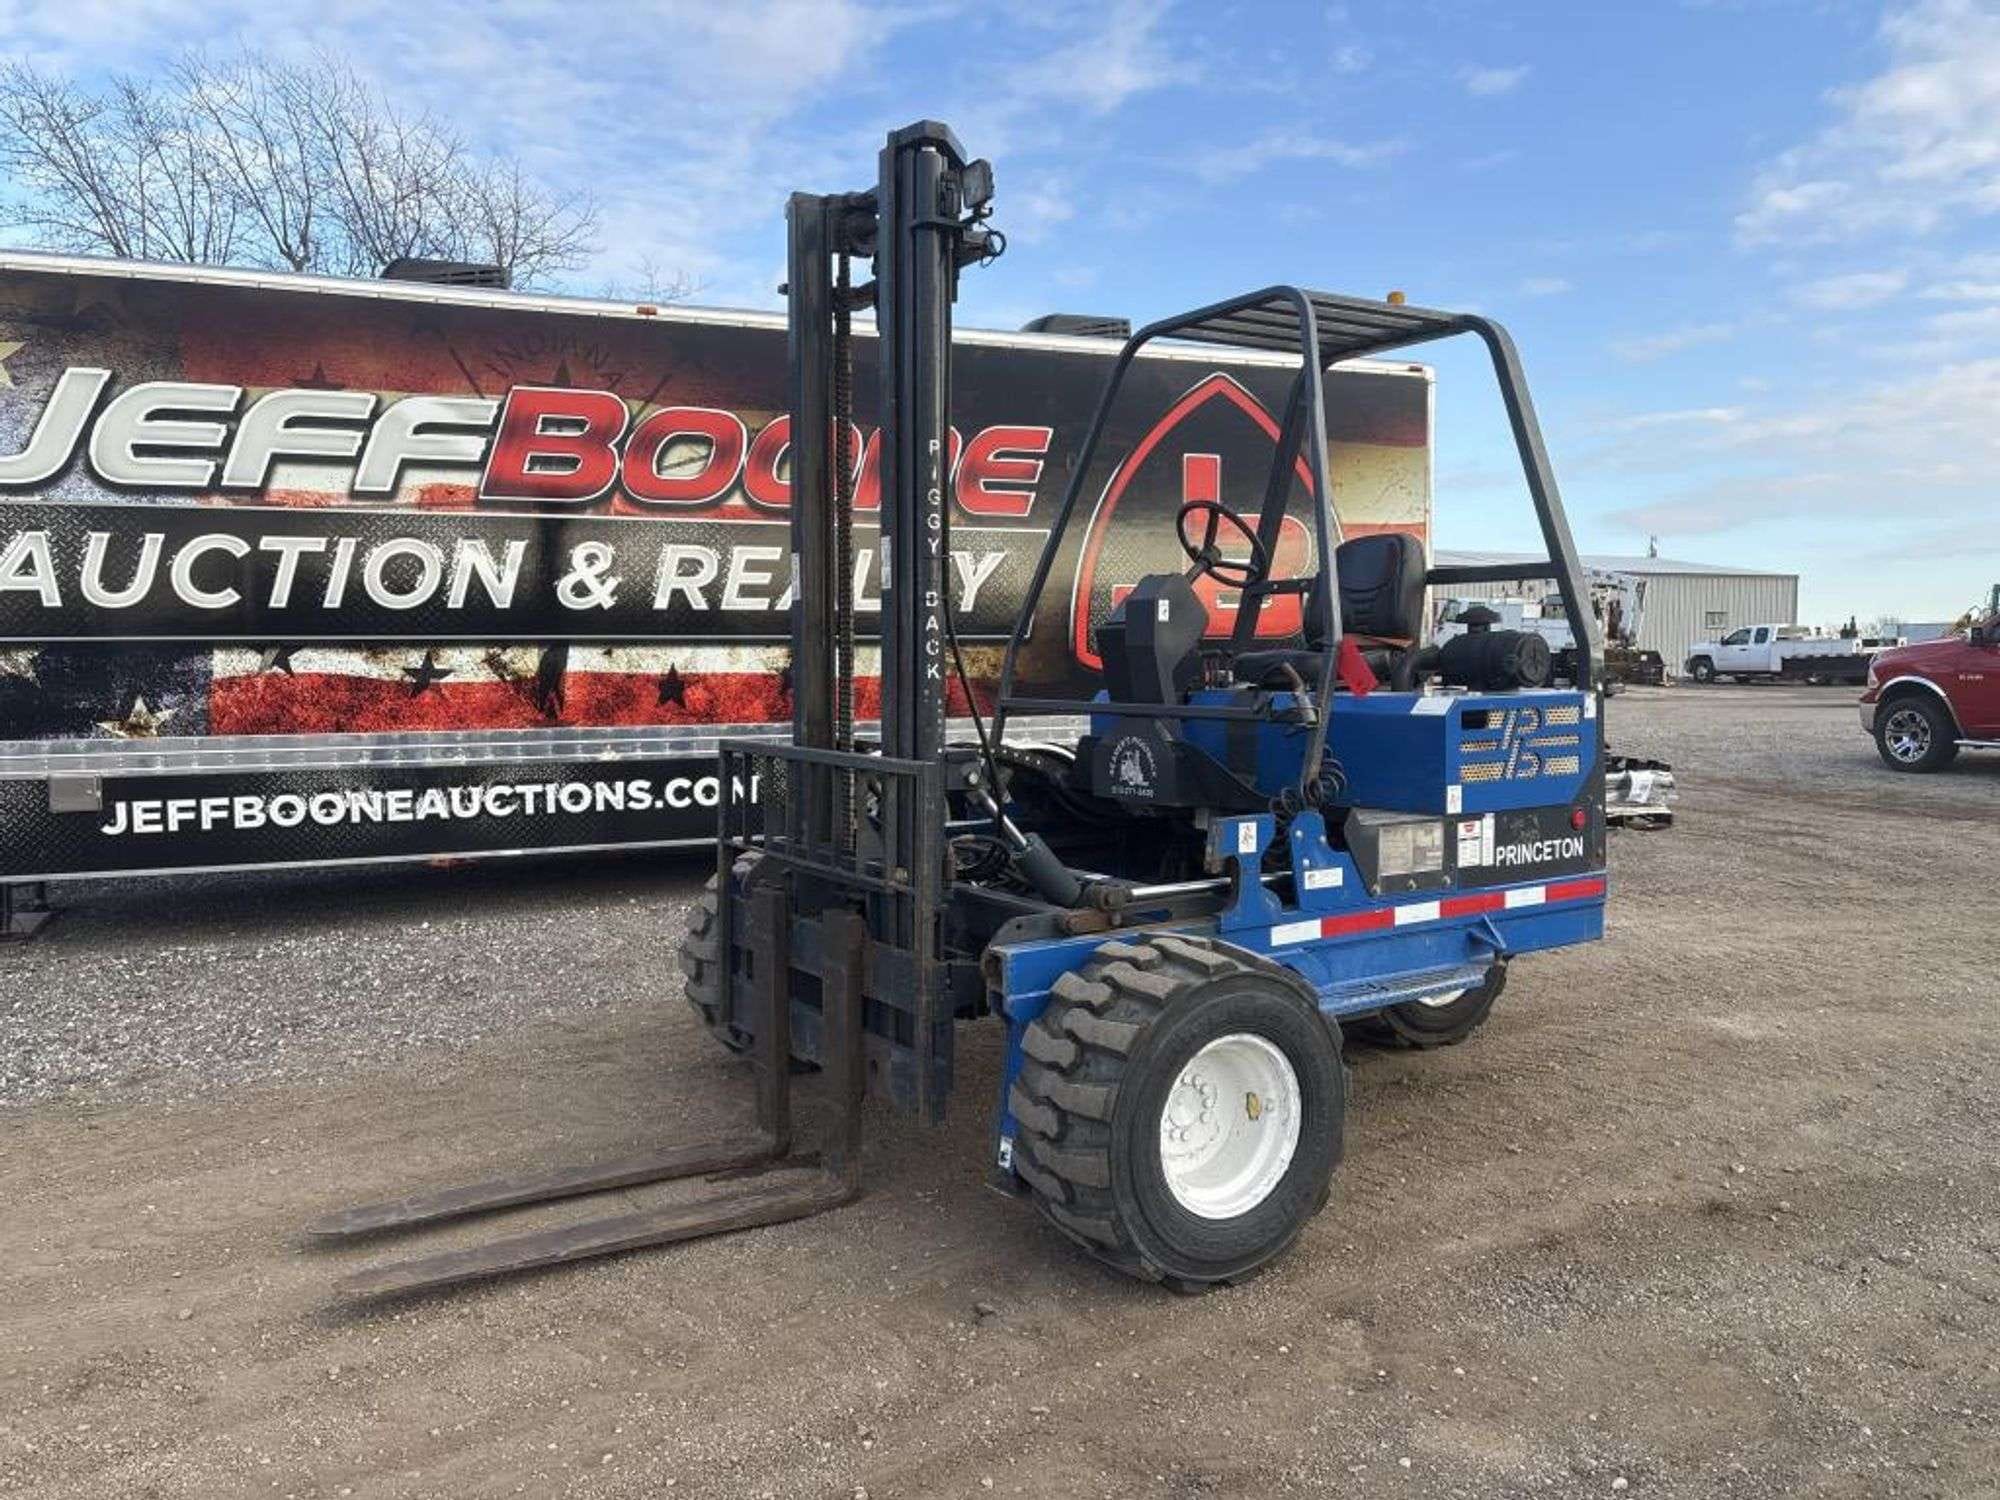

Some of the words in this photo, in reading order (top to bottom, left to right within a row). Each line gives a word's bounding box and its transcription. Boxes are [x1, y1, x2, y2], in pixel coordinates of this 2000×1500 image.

[926, 439, 941, 555] PIGGY
[0, 531, 526, 610] AUCTION
[557, 541, 622, 609] &
[652, 545, 1007, 612] RELY
[1495, 836, 1584, 867] PRINCETON
